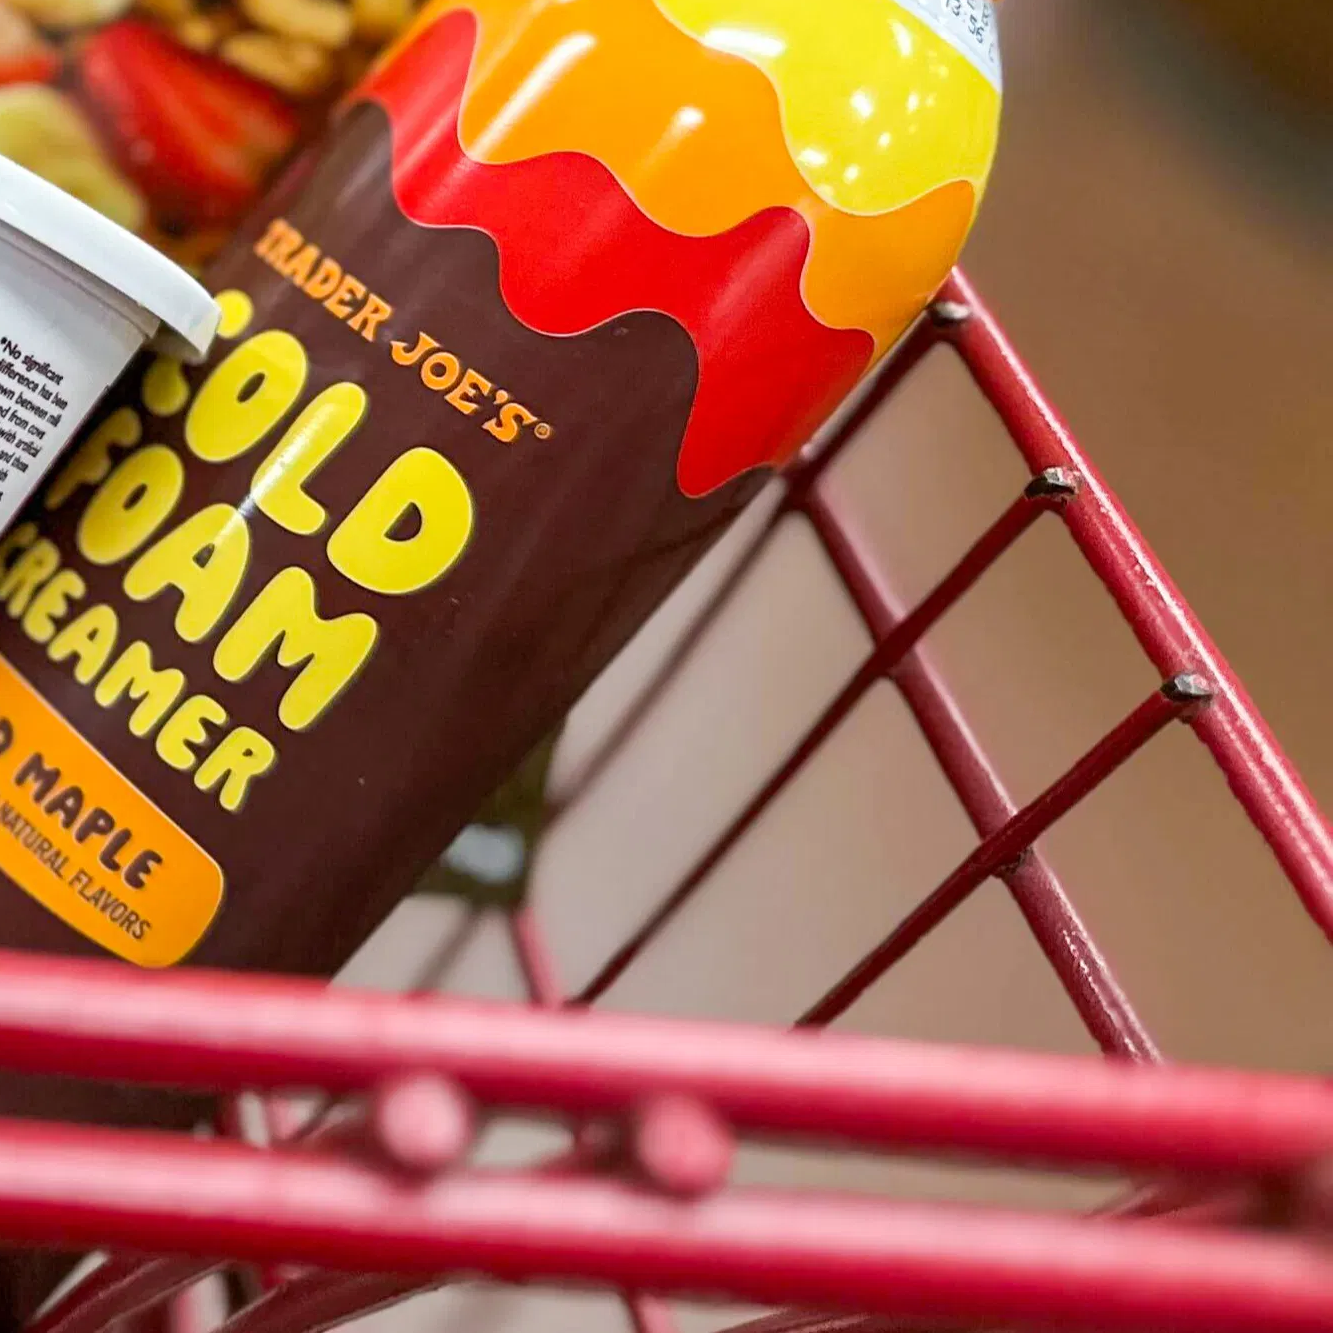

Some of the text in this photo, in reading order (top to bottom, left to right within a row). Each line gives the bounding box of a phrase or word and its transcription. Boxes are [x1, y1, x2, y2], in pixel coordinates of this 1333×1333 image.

[252, 217, 539, 443] TRADER JOE'S
[7, 406, 28, 432] from
[44, 406, 379, 731] FOAM
[13, 752, 164, 891] MAPLE
[67, 867, 153, 941] FLAVORS
